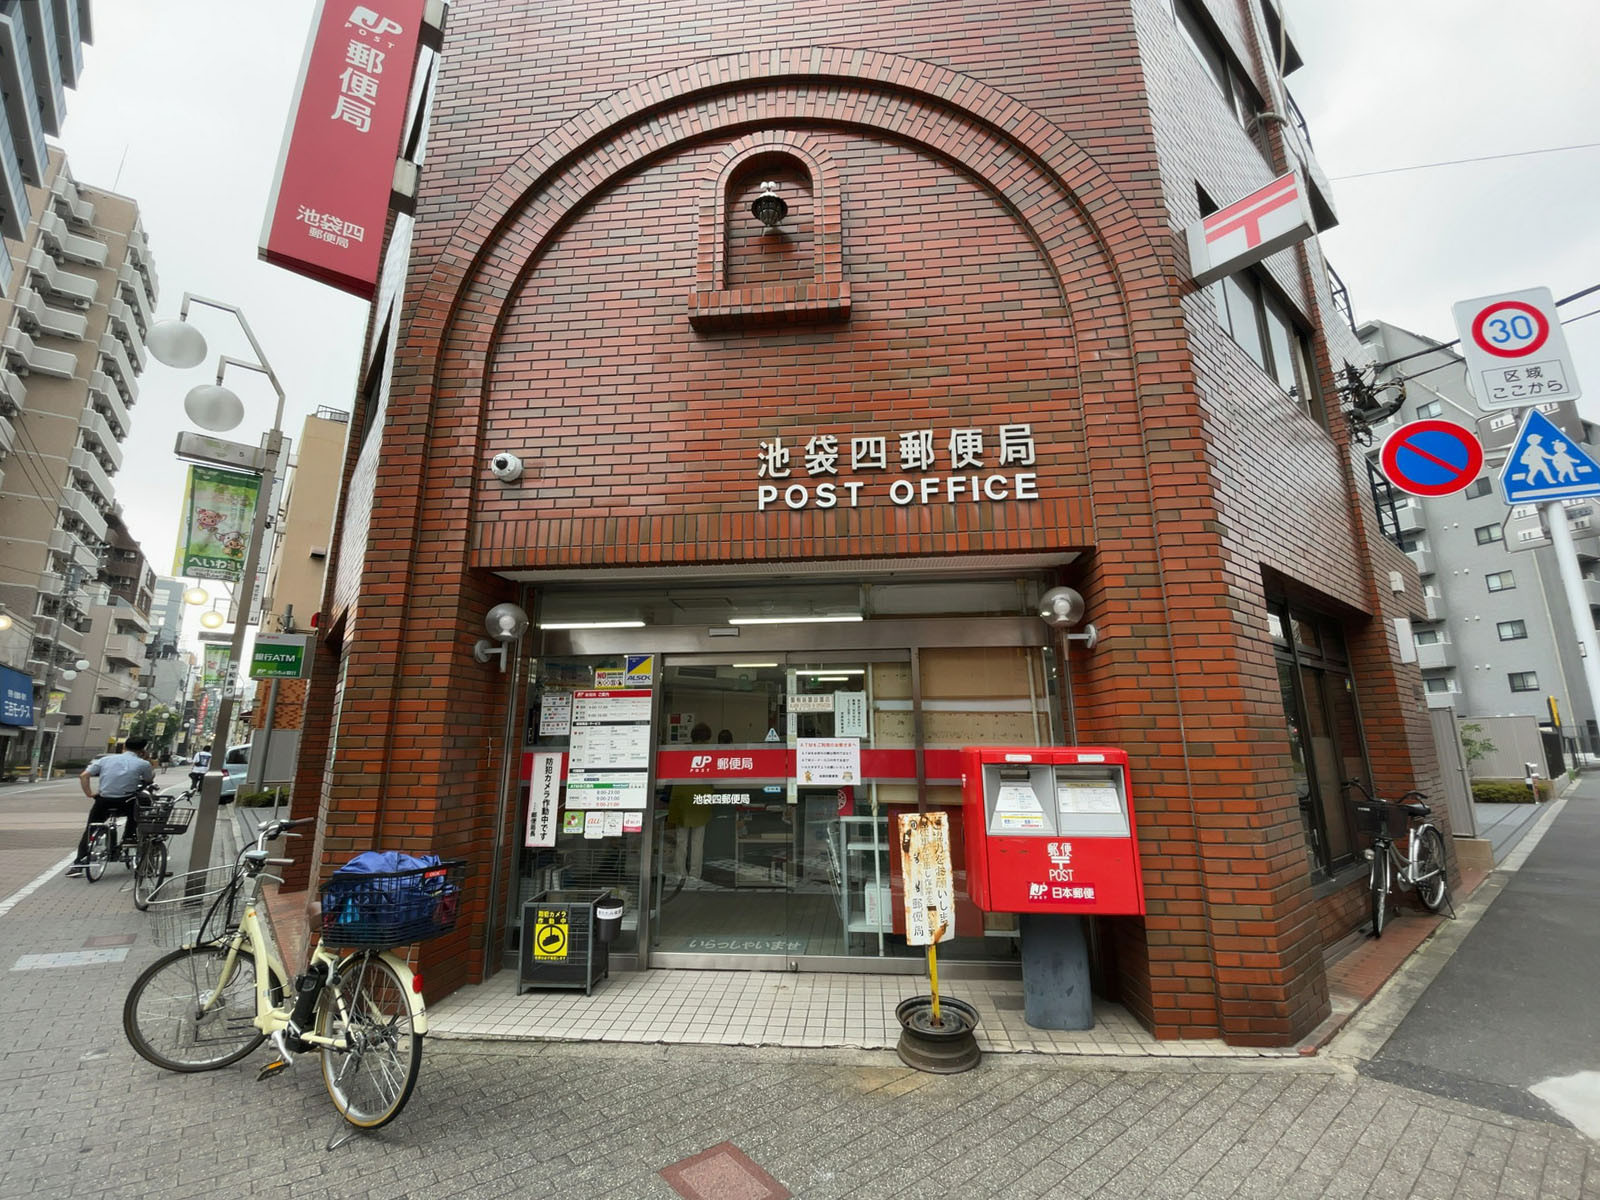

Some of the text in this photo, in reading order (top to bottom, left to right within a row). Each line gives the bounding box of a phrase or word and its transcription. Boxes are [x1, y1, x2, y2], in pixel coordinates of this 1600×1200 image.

[345, 22, 395, 48] POST
[331, 39, 385, 133] 郵便局
[296, 204, 365, 243] 池袋四
[308, 227, 350, 249] 郵便局
[1488, 315, 1533, 343] 30
[1493, 379, 1563, 399] ここから
[758, 424, 1036, 478] 池袋四郵便局
[758, 473, 1039, 511] POST OFFICE
[255, 653, 296, 662] 銀行ATM
[226, 664, 238, 694] 平和通り
[717, 757, 753, 770] 郵便局
[540, 757, 554, 840] 防犯カメラ作動中です
[693, 794, 750, 805] 池袋四郵便局
[1047, 842, 1073, 857] 郵便
[1049, 868, 1074, 881] POST
[1052, 887, 1095, 899] 日本郵便
[689, 939, 801, 951] いらっしゃいませ
